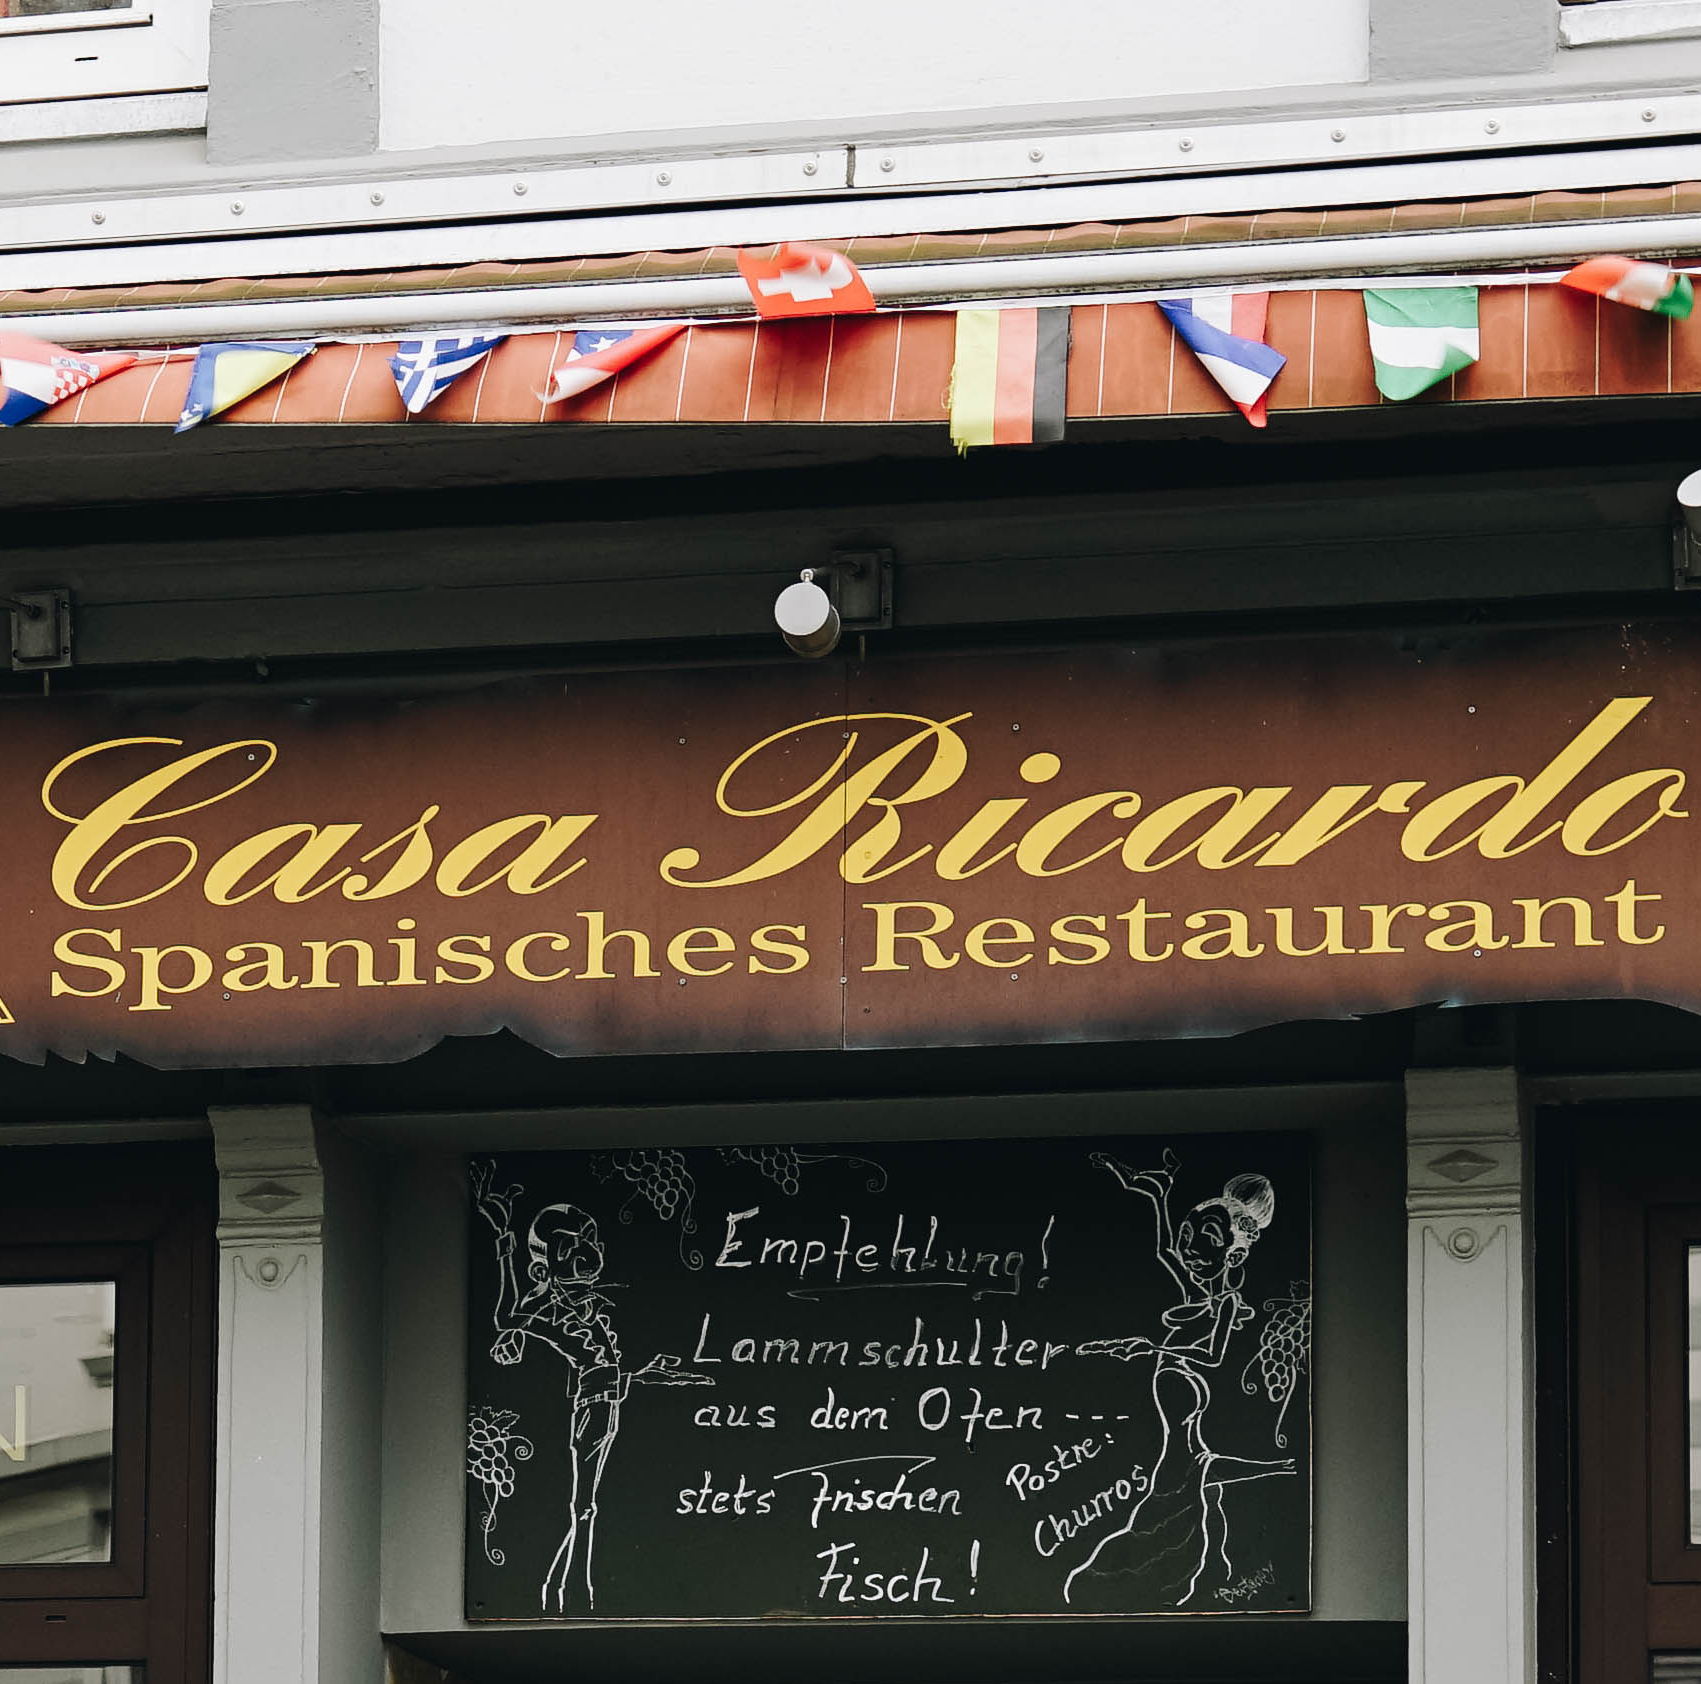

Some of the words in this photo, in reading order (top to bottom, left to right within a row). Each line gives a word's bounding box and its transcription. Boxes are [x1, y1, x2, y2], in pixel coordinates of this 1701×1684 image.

[41, 736, 599, 911] Casa
[659, 696, 1689, 889] Ricardo
[50, 909, 812, 1011] Spanisches
[860, 879, 1666, 975] Restaurant
[694, 1404, 778, 1428] aus
[810, 1386, 889, 1431] dem
[675, 1470, 776, 1516] stets
